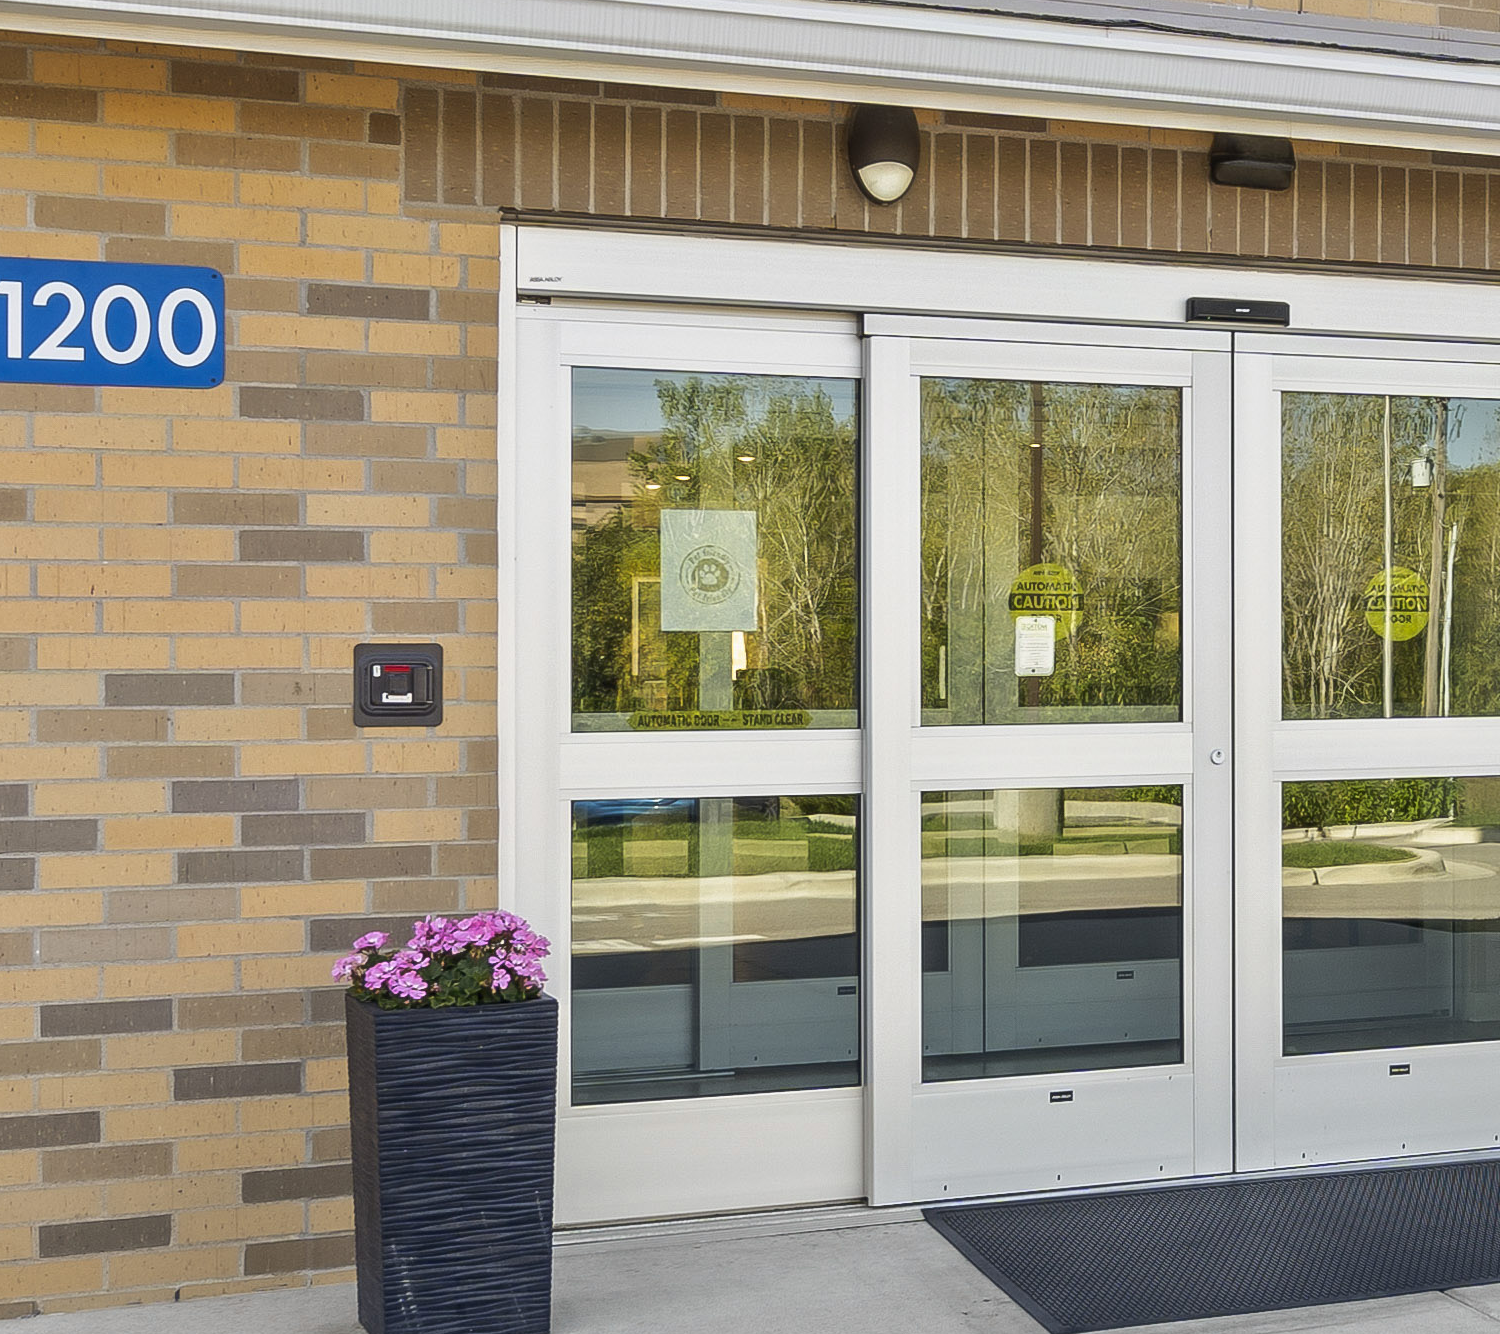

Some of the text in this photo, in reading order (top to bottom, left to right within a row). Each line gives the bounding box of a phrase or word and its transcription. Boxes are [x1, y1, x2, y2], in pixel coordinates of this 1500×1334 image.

[1367, 584, 1425, 593] AUOMATIC
[1013, 594, 1081, 609] CAUTION
[1385, 614, 1412, 624] OOR
[638, 713, 804, 727] AUTOMATIC DOOR STAND CLEAR
